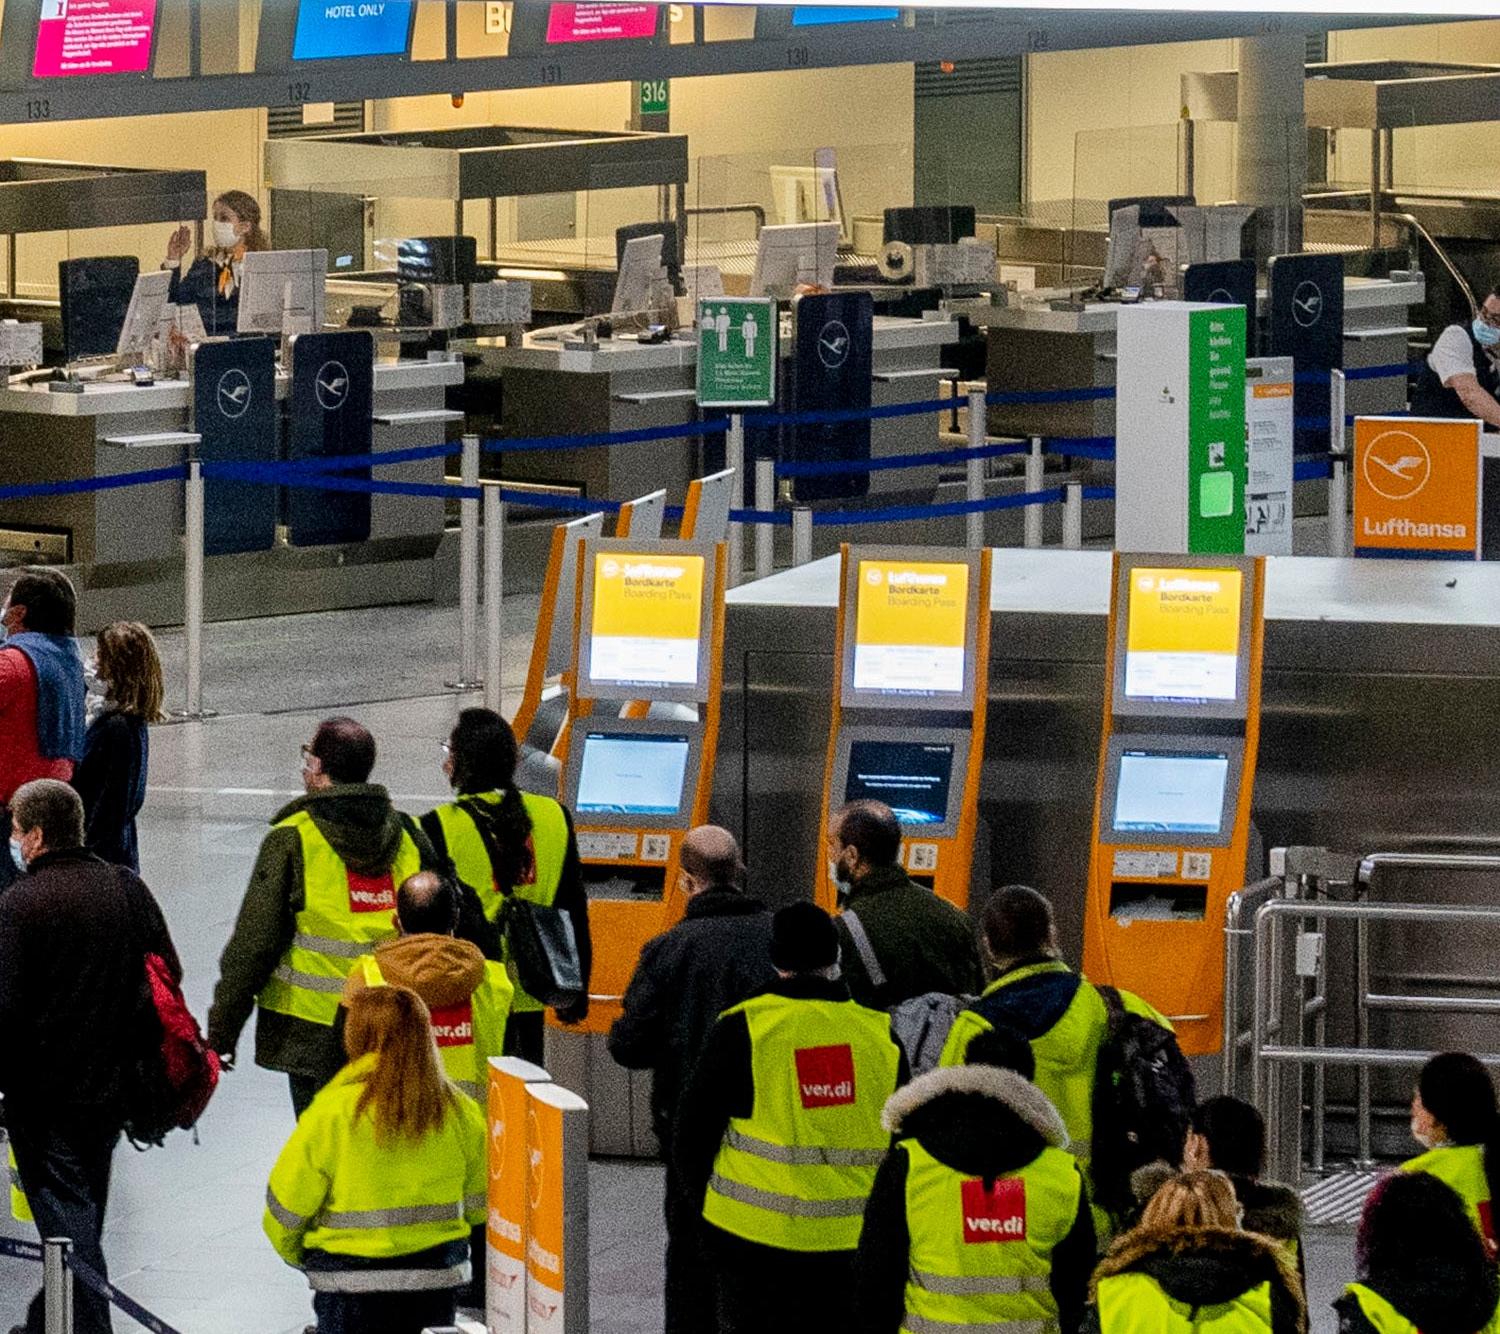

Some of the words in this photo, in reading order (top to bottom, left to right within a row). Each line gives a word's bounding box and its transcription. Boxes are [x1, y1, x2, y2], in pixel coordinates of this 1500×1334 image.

[324, 5, 358, 19] HOTEL
[358, 3, 386, 17] ONLY
[641, 80, 667, 104] 316
[27, 99, 51, 121] 133
[1362, 515, 1467, 539] Lufthansa
[624, 576, 676, 589] Bordkarte
[888, 584, 941, 596] Bordkarte
[623, 589, 668, 603] Boarding
[1159, 590, 1213, 604] Bordkarte
[350, 888, 394, 904] ver.di
[800, 1080, 853, 1100] ver.di
[965, 1215, 1025, 1236] ver.di
